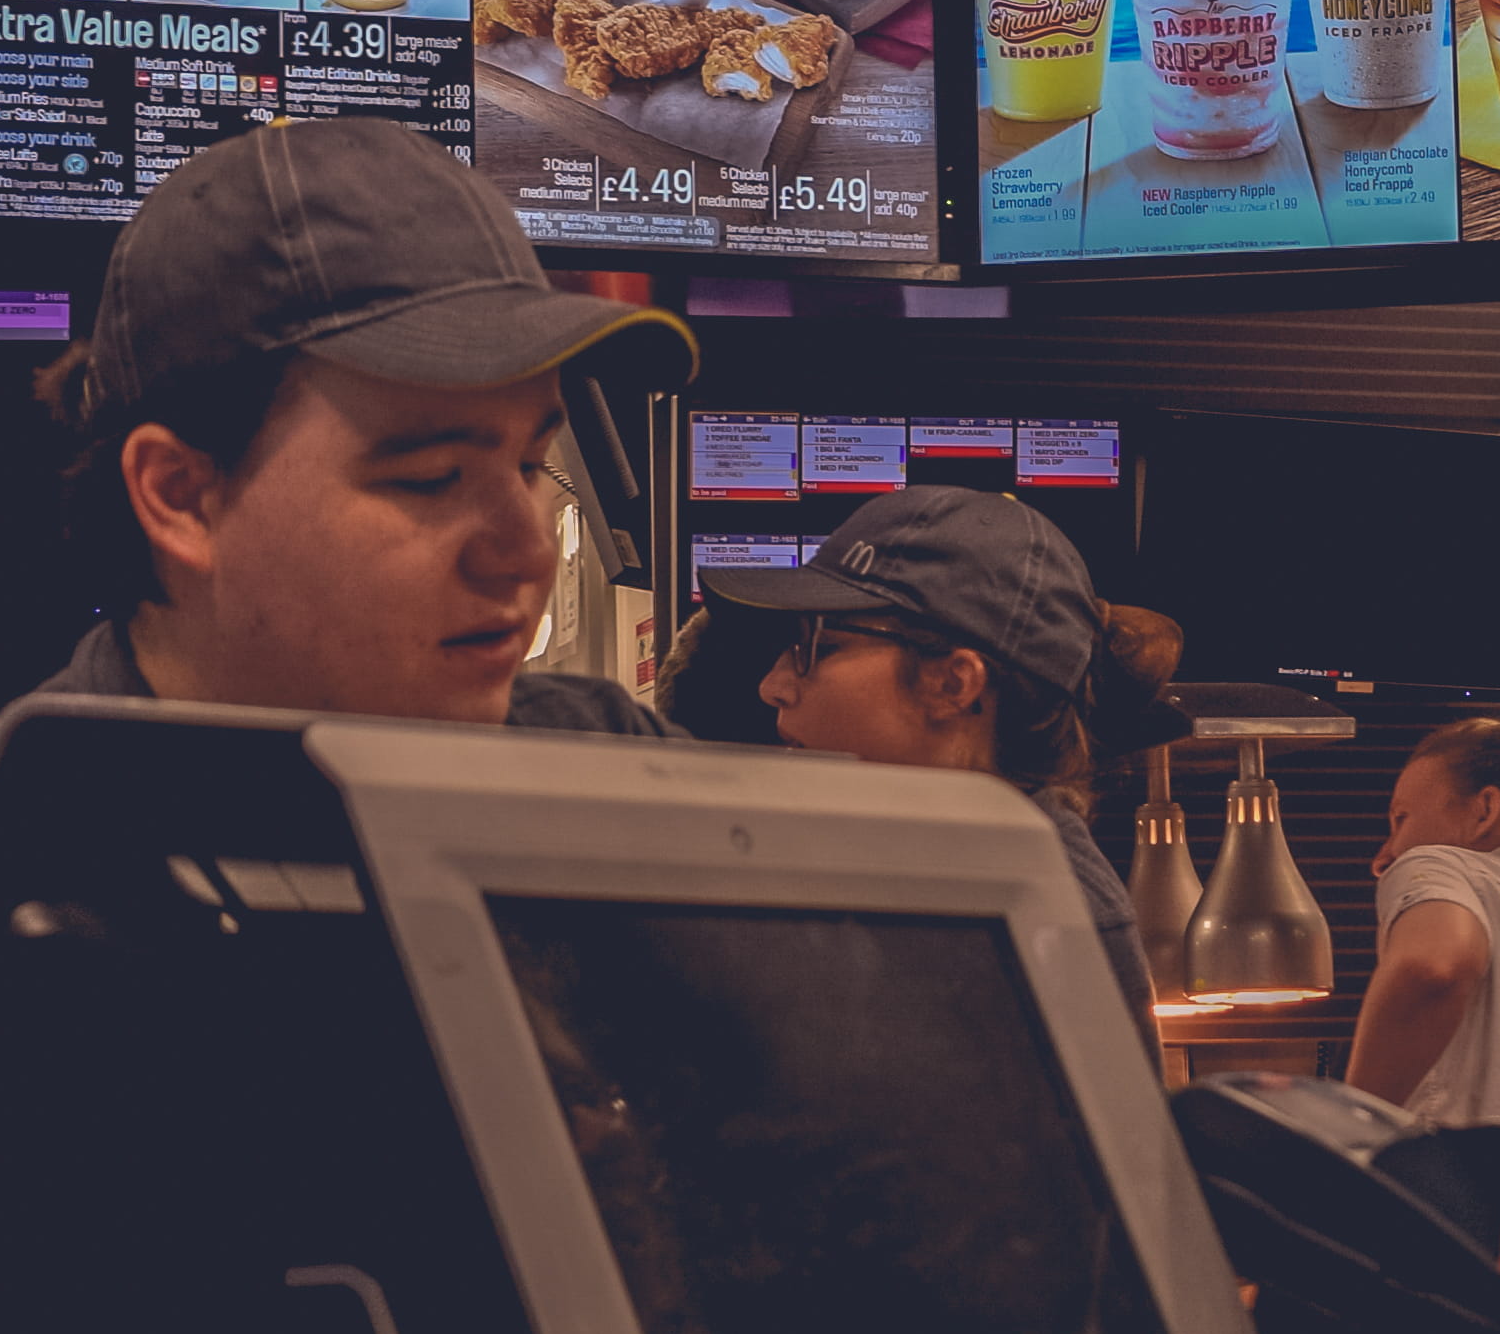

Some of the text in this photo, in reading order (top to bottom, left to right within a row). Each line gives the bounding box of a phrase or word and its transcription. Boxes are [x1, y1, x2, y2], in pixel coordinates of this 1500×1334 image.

[284, 13, 307, 23] from
[1153, 12, 1277, 38] RASPBERRY
[60, 8, 155, 48] Value
[1325, 18, 1432, 38] ICED FRAPPÉ
[291, 21, 386, 59] £4.39
[395, 33, 424, 51] large
[395, 50, 441, 66] add 40p
[999, 41, 1095, 60] LEMONADE
[1152, 34, 1277, 73] RIPPLE
[29, 53, 60, 69] your
[61, 53, 94, 69] main
[135, 57, 237, 75] Medium Soft Drink
[29, 73, 60, 89] your
[61, 73, 89, 89] side
[285, 65, 401, 83] Limited Edition Drinks
[1164, 69, 1269, 87] ICED COOLER
[22, 92, 49, 106] Fries
[15, 109, 37, 122] Side
[135, 102, 201, 120] Cappuccino
[28, 132, 59, 147] your
[61, 132, 96, 147] drink
[135, 129, 165, 143] Latte
[900, 130, 922, 146] 20p
[1344, 146, 1449, 165] Belgian Chocolate
[542, 157, 592, 173] 3 Chicken
[1344, 162, 1414, 180] Honeycomb
[554, 172, 592, 188] Selects
[720, 166, 769, 182] 5 Chicken
[991, 167, 1033, 180] Frozen
[601, 166, 693, 205] £4.49
[731, 181, 769, 196] Selects
[992, 180, 1063, 195] Strawberry
[1345, 176, 1414, 193] Iced Frappé
[520, 187, 563, 201] medium
[779, 175, 867, 214] £5.49
[874, 188, 899, 204] large
[1142, 184, 1276, 203] NEW Raspberry Ripple
[699, 195, 740, 209] medium
[992, 195, 1053, 210] Lemonade
[1143, 203, 1168, 217] Iced
[1170, 201, 1209, 216] Cooler
[874, 203, 918, 219] add 40p
[10, 307, 37, 316] ZERO
